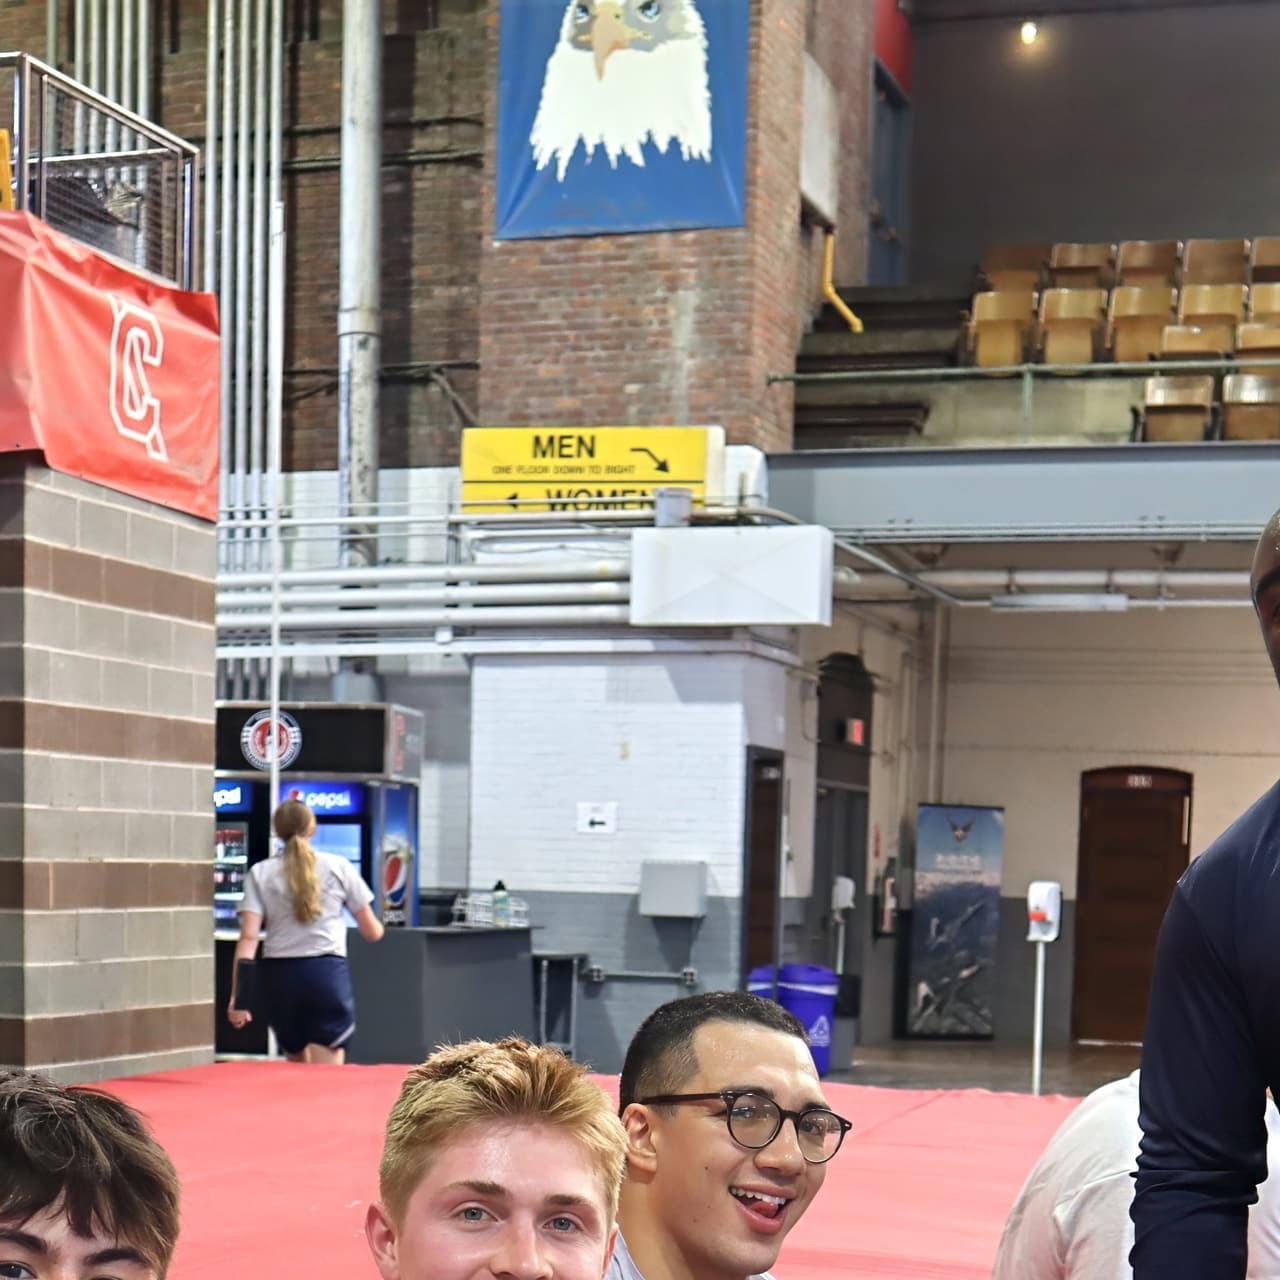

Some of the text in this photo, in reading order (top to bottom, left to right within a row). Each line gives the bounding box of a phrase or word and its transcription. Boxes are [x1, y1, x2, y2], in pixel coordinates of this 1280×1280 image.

[532, 434, 596, 459] MEN
[545, 488, 656, 512] WOMEN
[305, 789, 352, 810] pepsi
